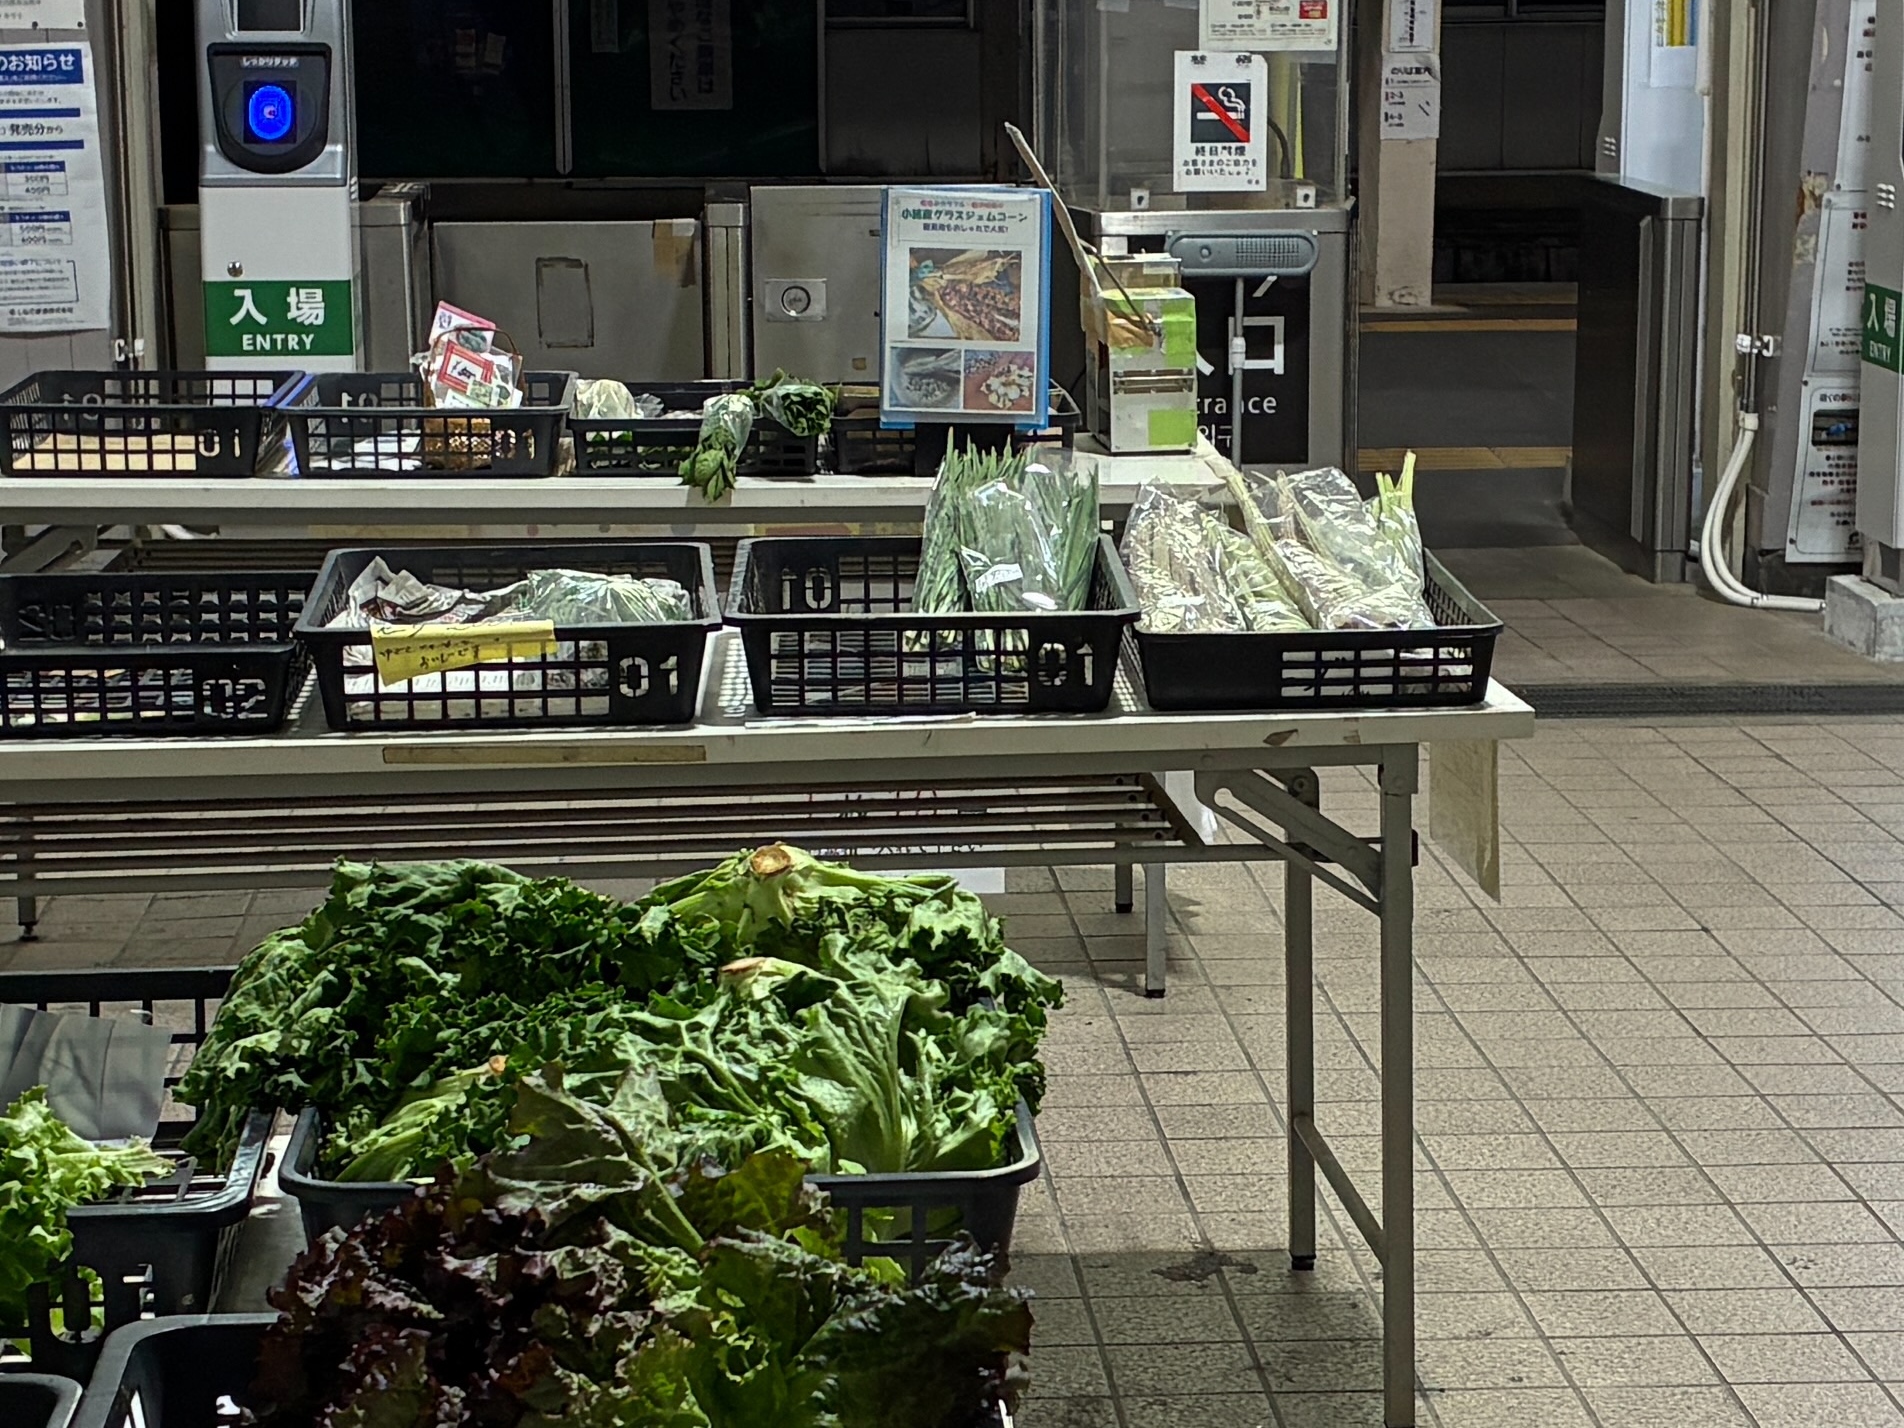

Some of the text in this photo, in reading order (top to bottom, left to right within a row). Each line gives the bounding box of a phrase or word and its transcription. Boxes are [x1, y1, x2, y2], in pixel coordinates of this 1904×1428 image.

[229, 288, 326, 326] 入場
[242, 334, 314, 352] ENTRY
[619, 655, 678, 698] 01
[1037, 641, 1095, 689] 01
[202, 678, 269, 719] 02
